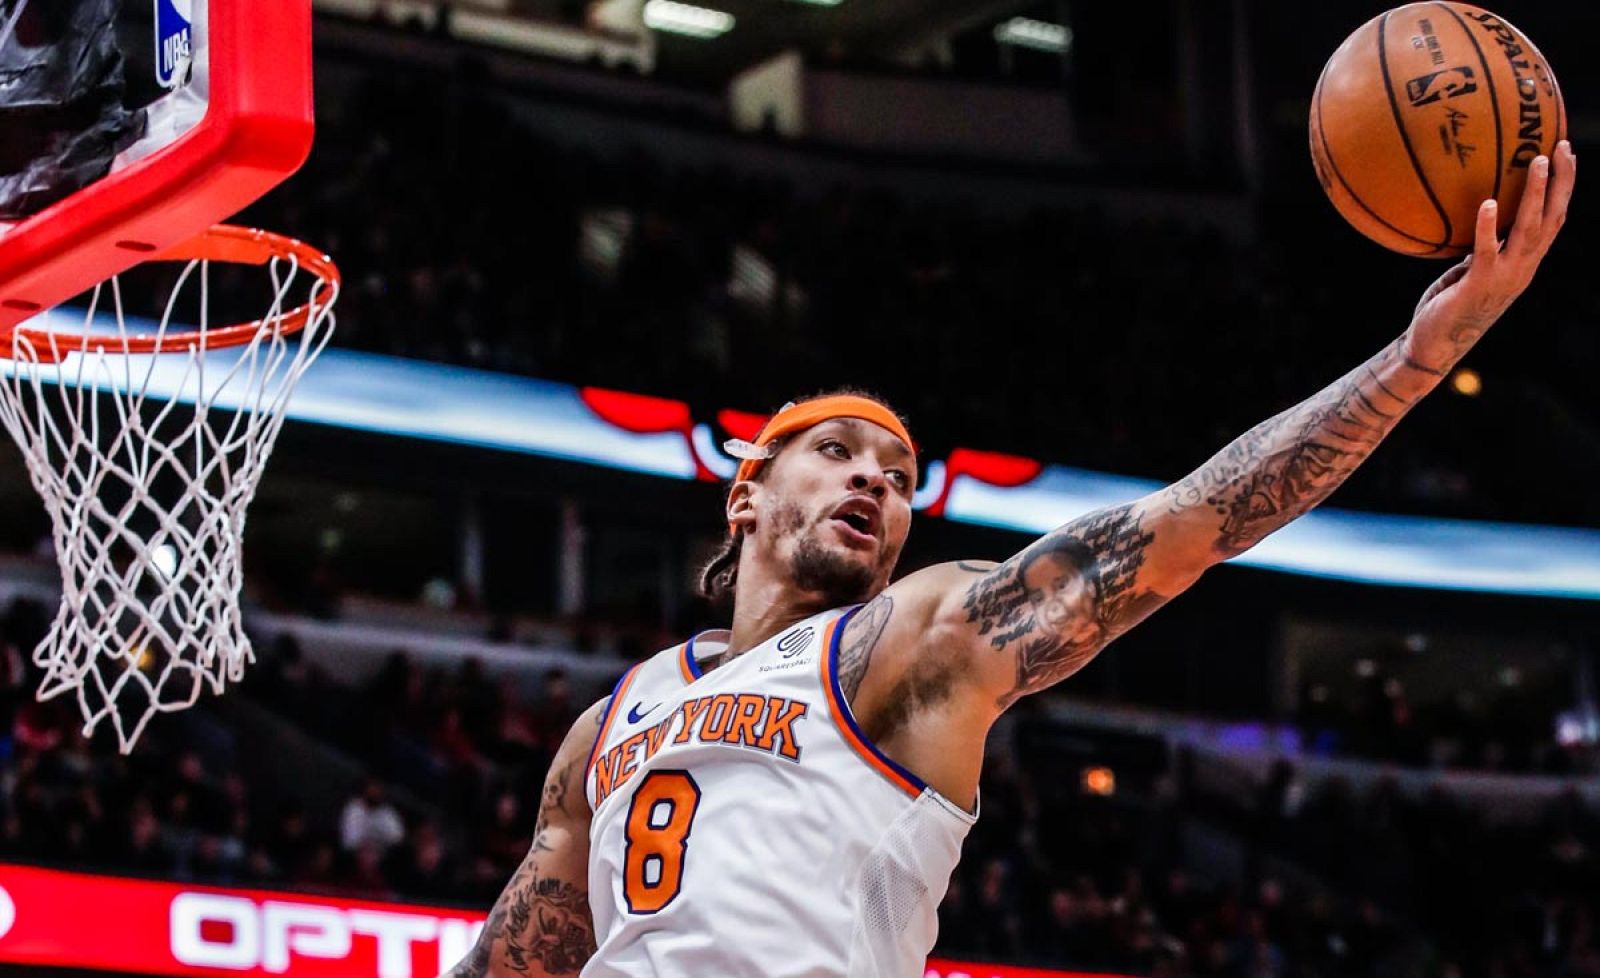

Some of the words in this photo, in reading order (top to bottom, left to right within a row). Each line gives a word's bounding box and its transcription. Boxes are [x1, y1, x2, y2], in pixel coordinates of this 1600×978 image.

[1464, 11, 1543, 169] SPALDING
[595, 706, 680, 808] NEW
[672, 693, 810, 763] YORK
[623, 770, 702, 914] 8
